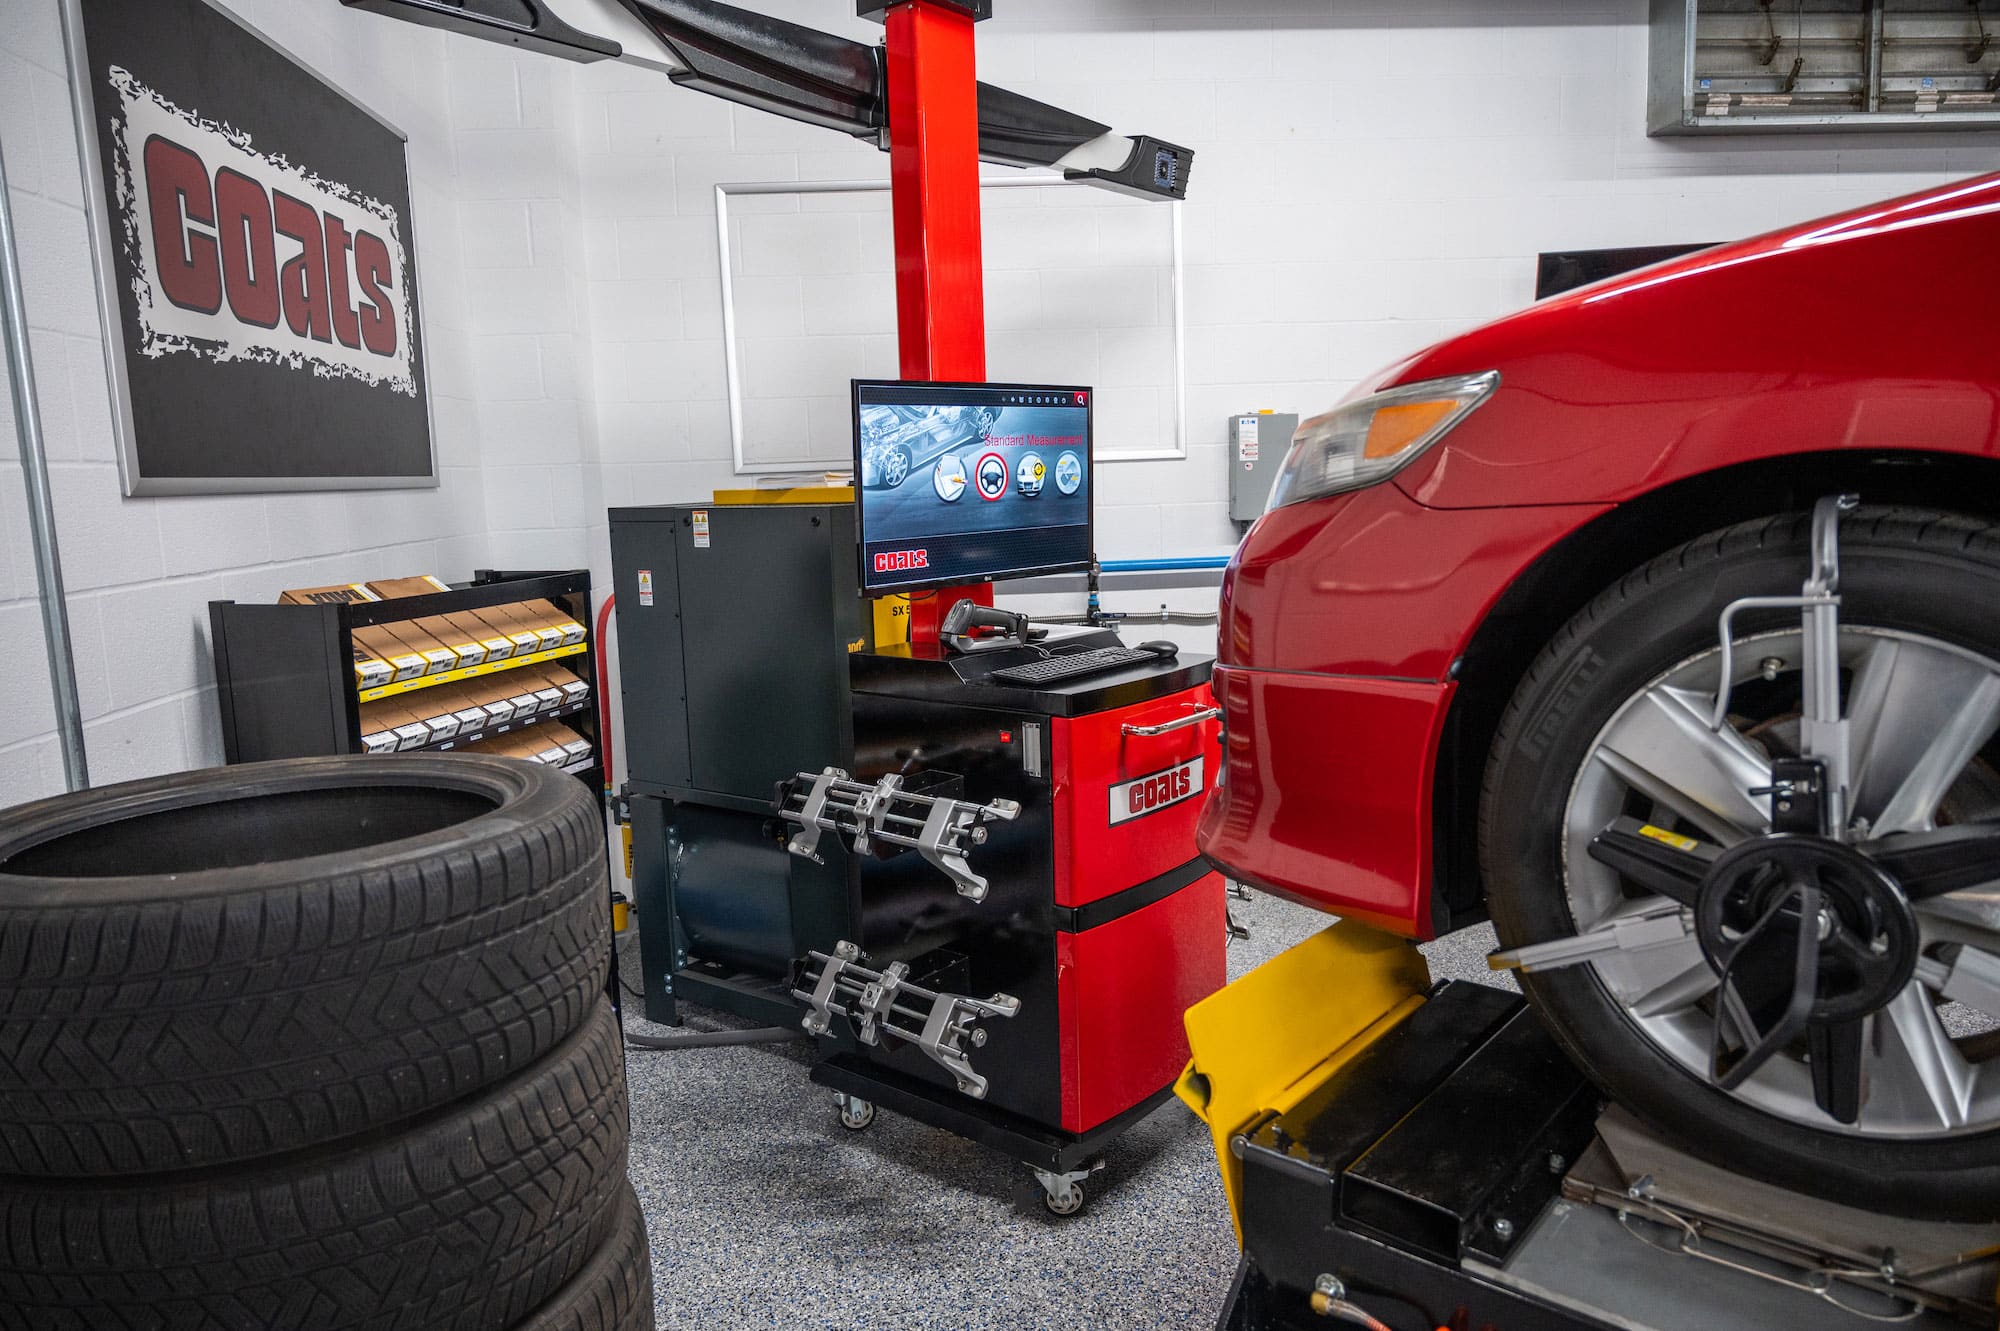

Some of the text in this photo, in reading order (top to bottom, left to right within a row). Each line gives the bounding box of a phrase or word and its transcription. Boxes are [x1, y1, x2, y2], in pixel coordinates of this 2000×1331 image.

[984, 433, 1083, 447] Standard Measurement
[892, 606, 905, 617] SX
[1518, 645, 1605, 759] PIRELLI
